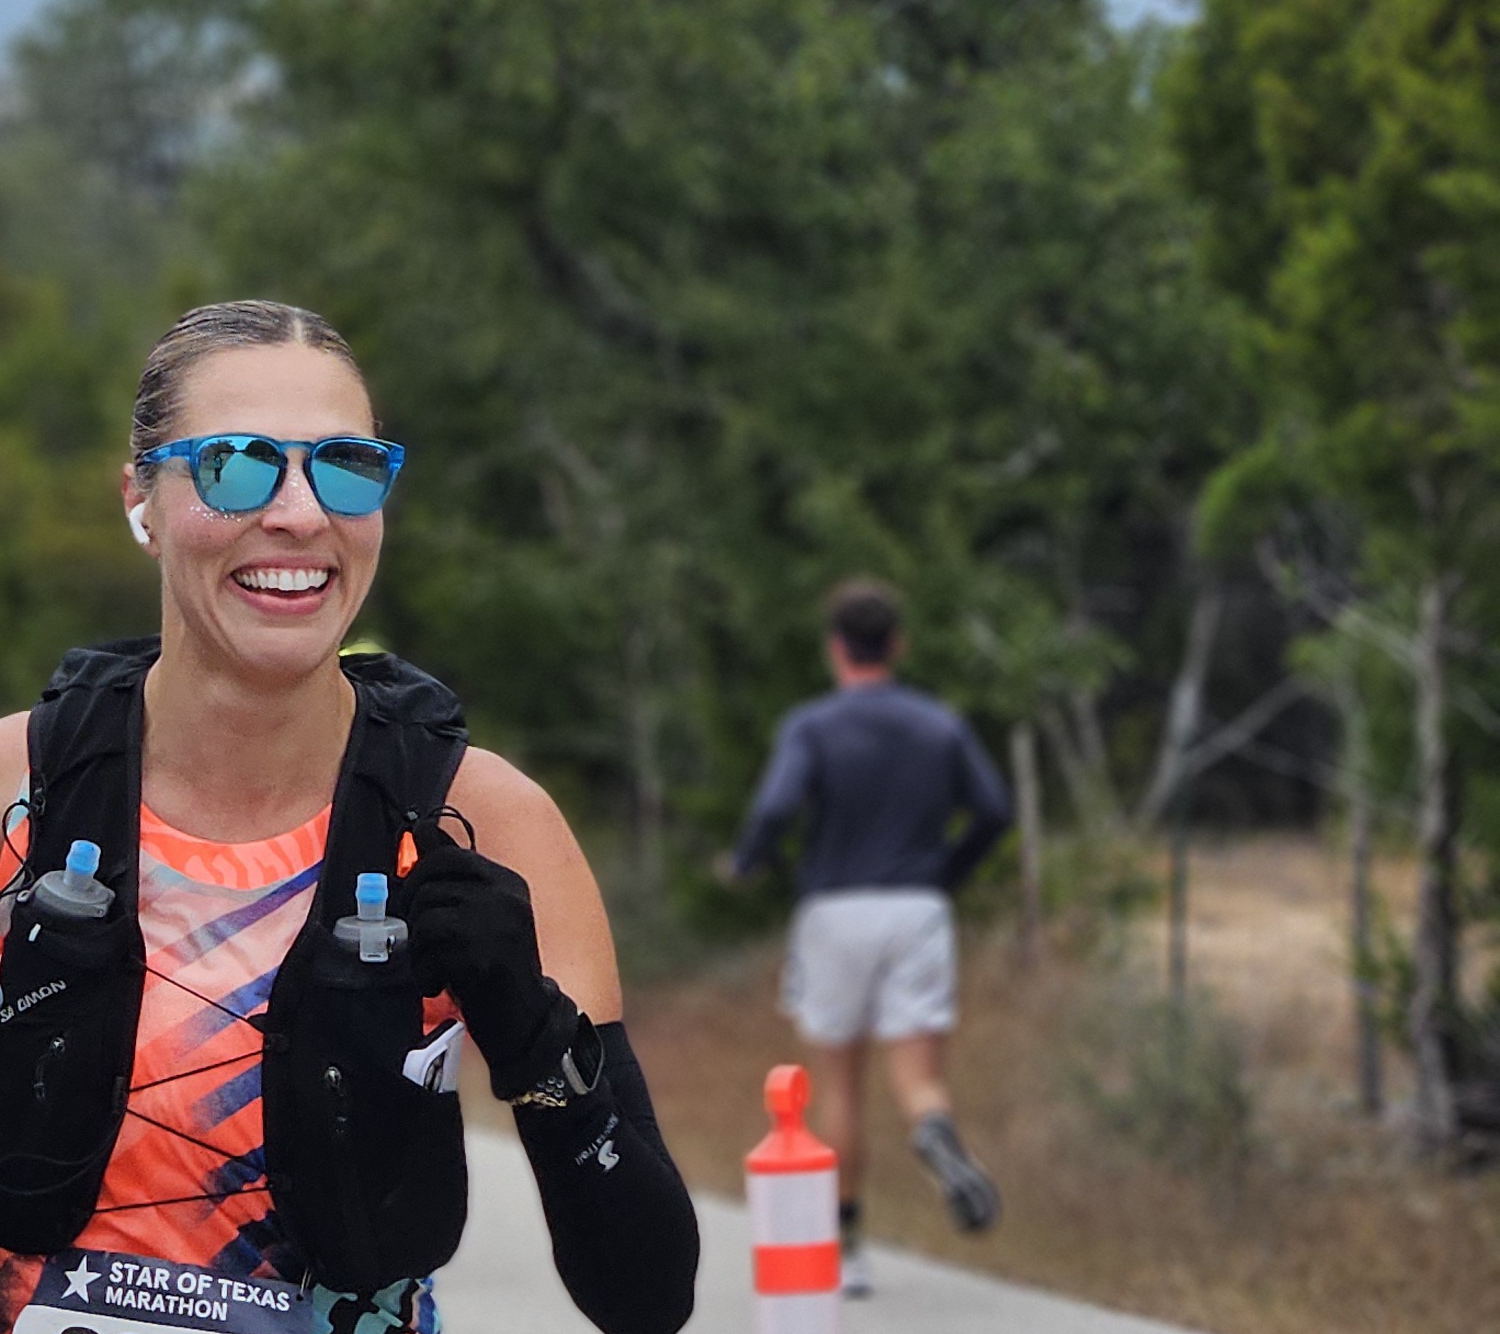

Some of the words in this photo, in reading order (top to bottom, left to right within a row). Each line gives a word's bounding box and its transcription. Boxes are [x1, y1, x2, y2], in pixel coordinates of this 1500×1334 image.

[0, 979, 67, 1023] SAOMON
[105, 1286, 228, 1321] MARATHON
[109, 1260, 170, 1291] STAR
[177, 1272, 213, 1295] OF
[217, 1278, 291, 1312] TEXAS
